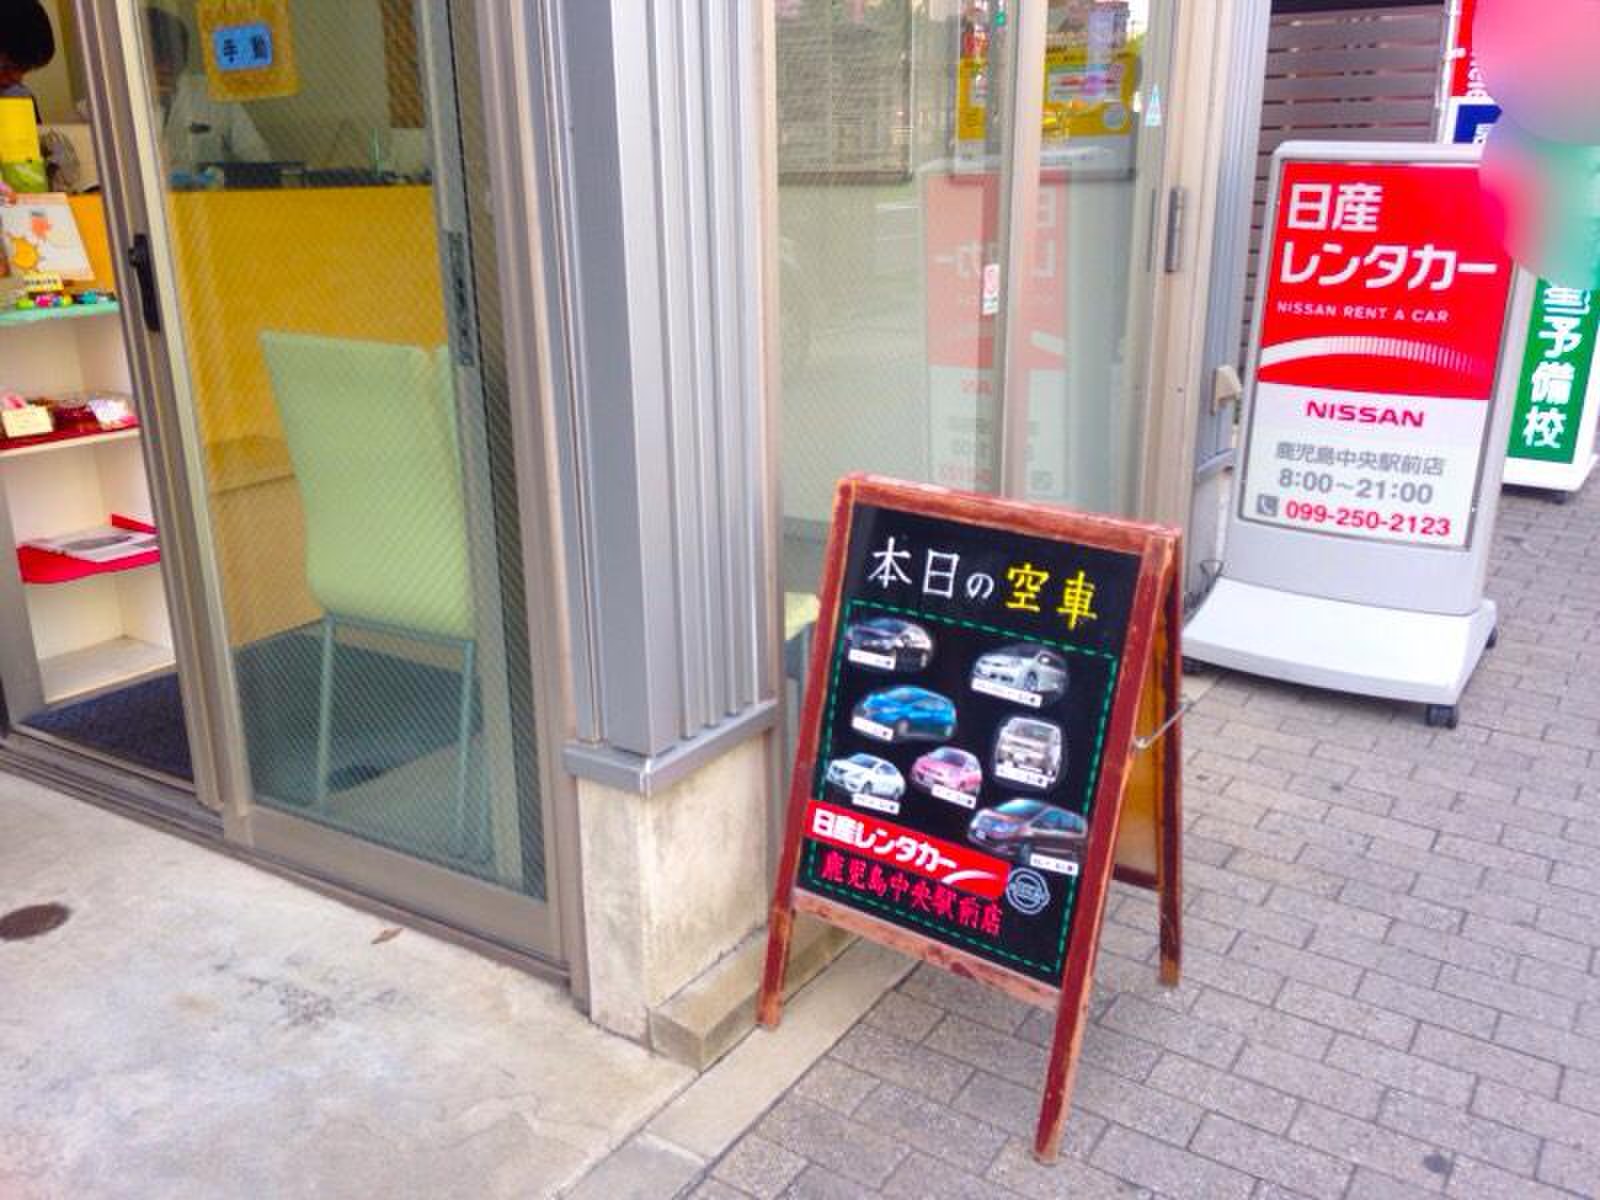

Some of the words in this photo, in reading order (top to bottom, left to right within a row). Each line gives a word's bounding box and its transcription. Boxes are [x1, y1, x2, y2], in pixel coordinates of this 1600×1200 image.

[1287, 182, 1383, 232] 日産
[1280, 240, 1498, 291] レンタカー
[1277, 301, 1337, 317] NISSAN
[1343, 305, 1388, 321] RENT
[1396, 309, 1406, 320] A
[1411, 309, 1450, 323] CAR
[1306, 400, 1425, 428] NISSAN
[1275, 441, 1446, 476] 鹿児島中央駅前店
[1285, 500, 1451, 537] 099-250-2123
[812, 808, 957, 872] 日産レンタカー
[821, 850, 1003, 936] 鹿児島中央駅前店
